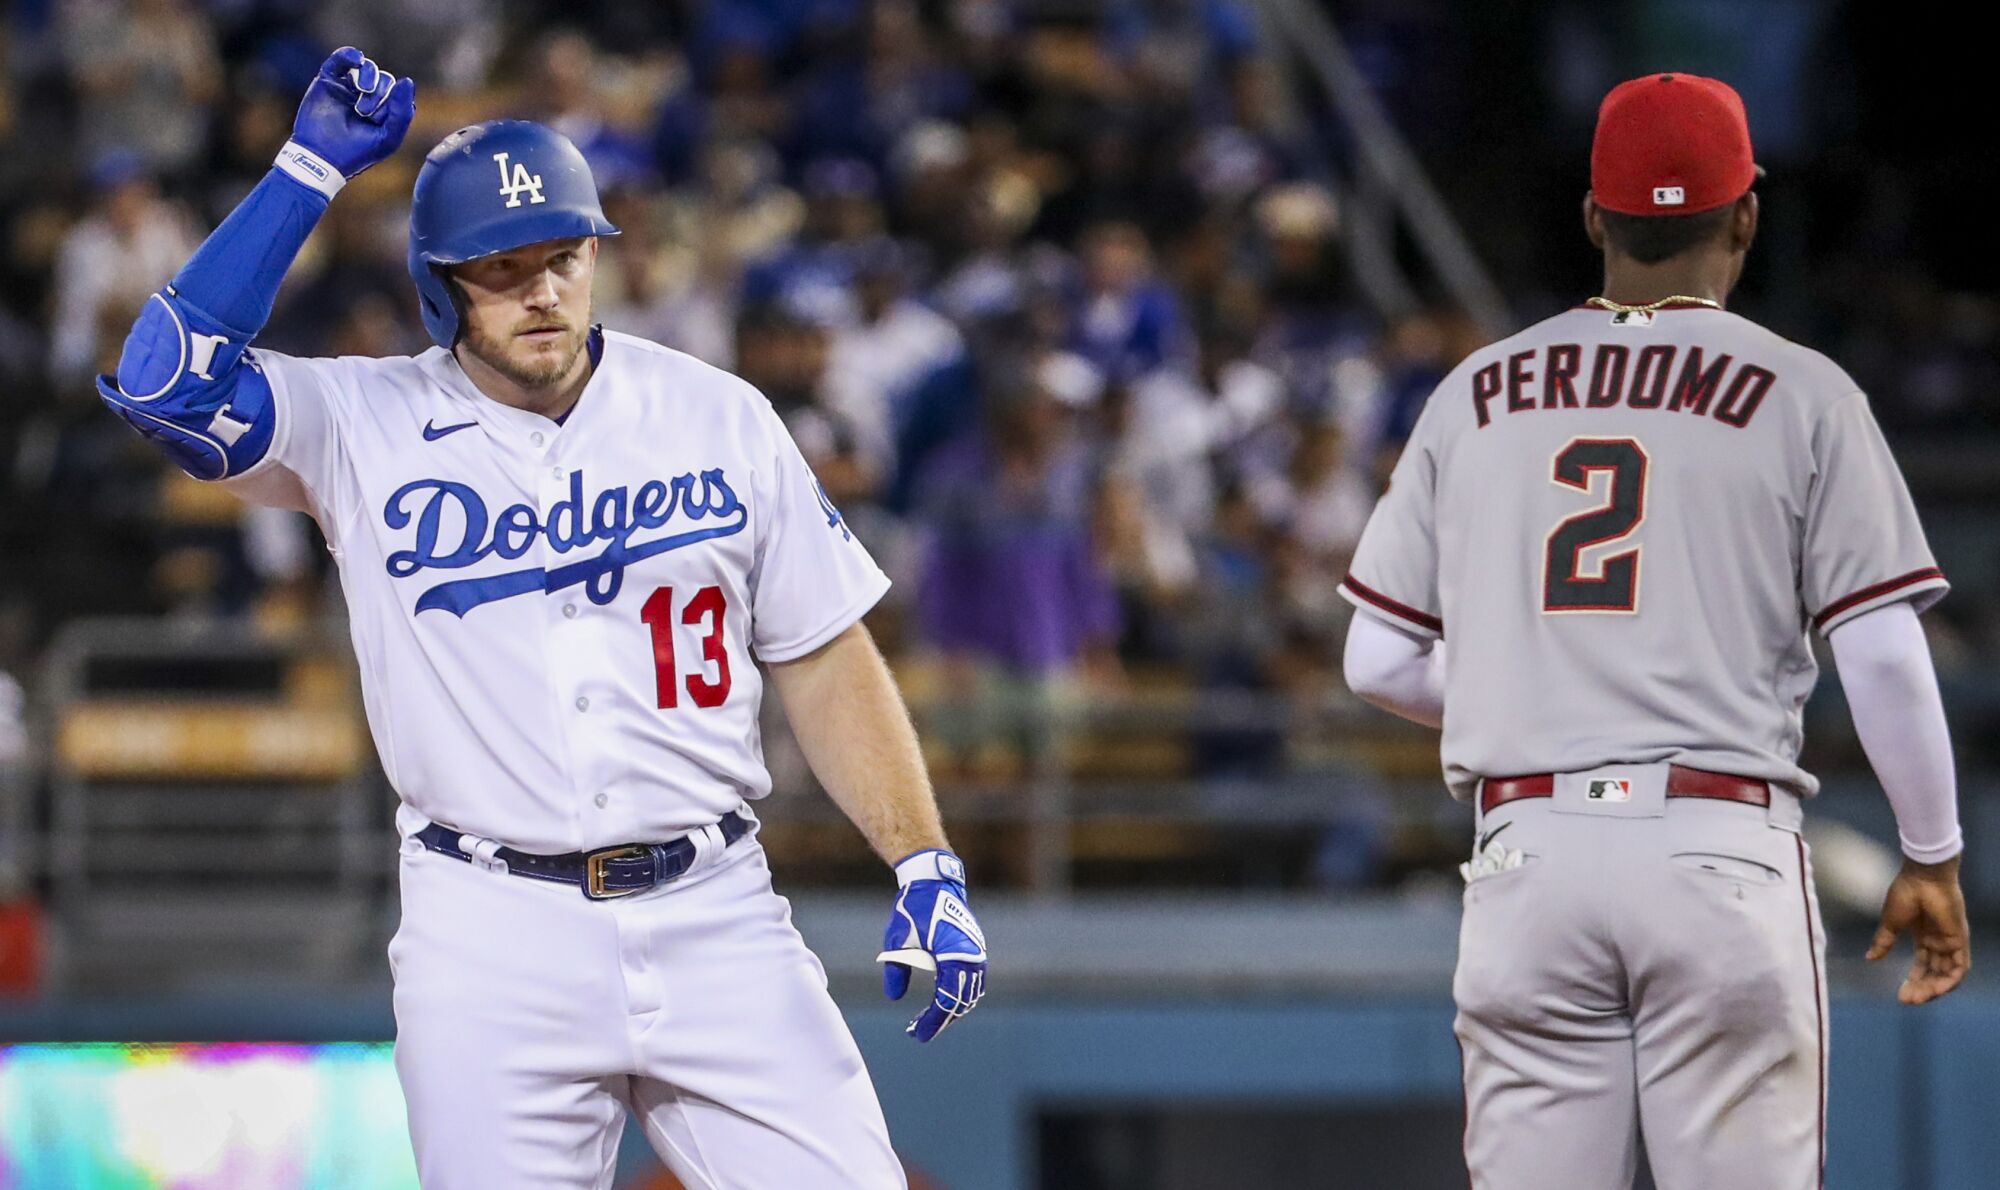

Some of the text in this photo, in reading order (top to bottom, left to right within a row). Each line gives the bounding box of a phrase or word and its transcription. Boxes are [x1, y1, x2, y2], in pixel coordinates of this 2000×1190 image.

[493, 152, 546, 208] LA
[1472, 343, 1777, 429] PERDOMO
[384, 467, 748, 606] Dodgers
[1541, 435, 1650, 615] 2
[640, 586, 732, 709] 13
